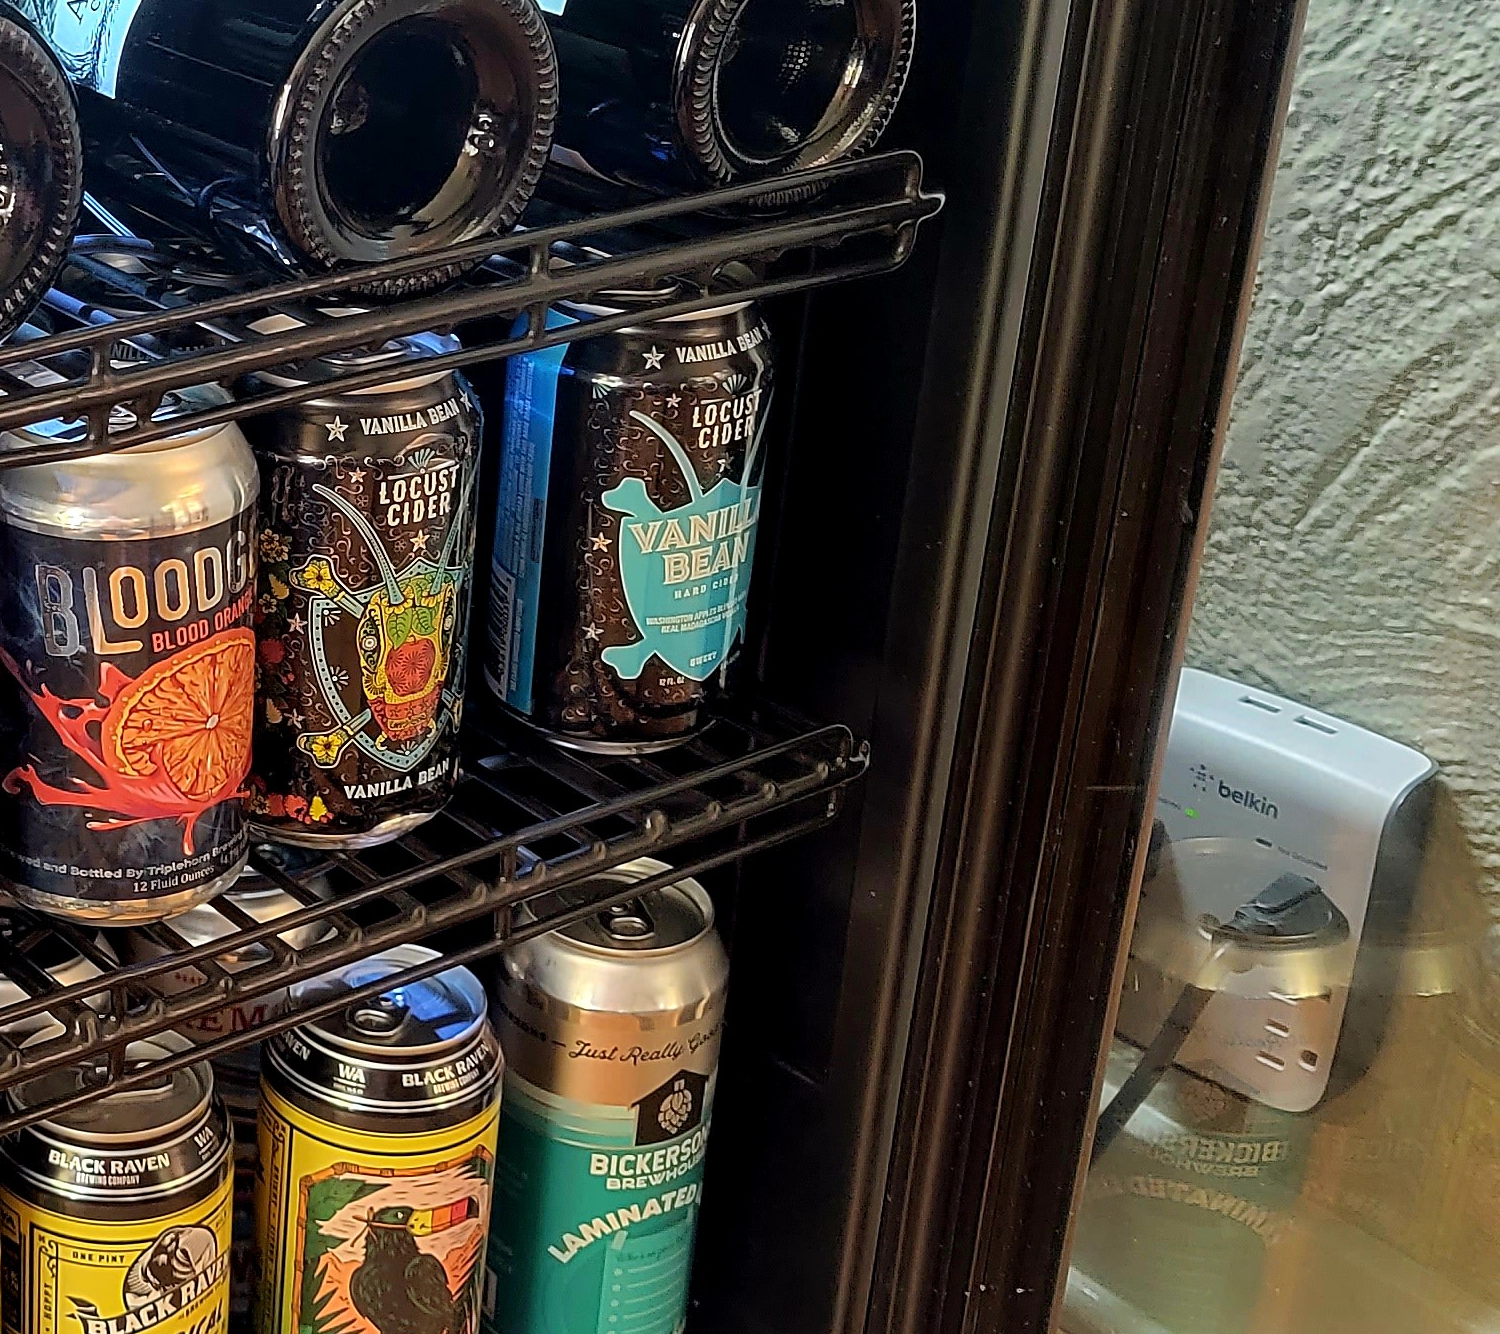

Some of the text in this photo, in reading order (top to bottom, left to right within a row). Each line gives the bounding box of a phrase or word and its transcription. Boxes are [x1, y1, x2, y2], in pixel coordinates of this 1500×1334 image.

[676, 327, 763, 363] VANILLA BEAN
[360, 398, 460, 435] VANILLA BEAN
[692, 389, 762, 427] LOCUST
[698, 416, 755, 449] CIDER
[379, 464, 460, 505] LOCUST
[387, 492, 451, 527] CIDER
[628, 499, 757, 554] VANILL
[663, 532, 749, 585] BEAN
[35, 531, 253, 657] BLOODG
[674, 585, 707, 599] HARD
[152, 619, 210, 653] BLOOD
[344, 758, 449, 799] VANILLA BEAN
[1218, 780, 1278, 819] belkin
[71, 866, 122, 879] Bottled
[126, 868, 143, 880] By
[148, 853, 210, 876] Triplehorn
[133, 866, 214, 893] 12 Fluid Ounces
[402, 1041, 489, 1087] BLACK RAVEN
[568, 1040, 683, 1065] Just Really
[338, 1064, 366, 1083] WA
[194, 1126, 214, 1147] WA
[49, 1149, 170, 1174] BLACK RAVEN
[76, 1173, 140, 1185] BREWING COMPANY
[548, 1183, 698, 1263] LAMINATED
[73, 1251, 125, 1264] ONE PINT
